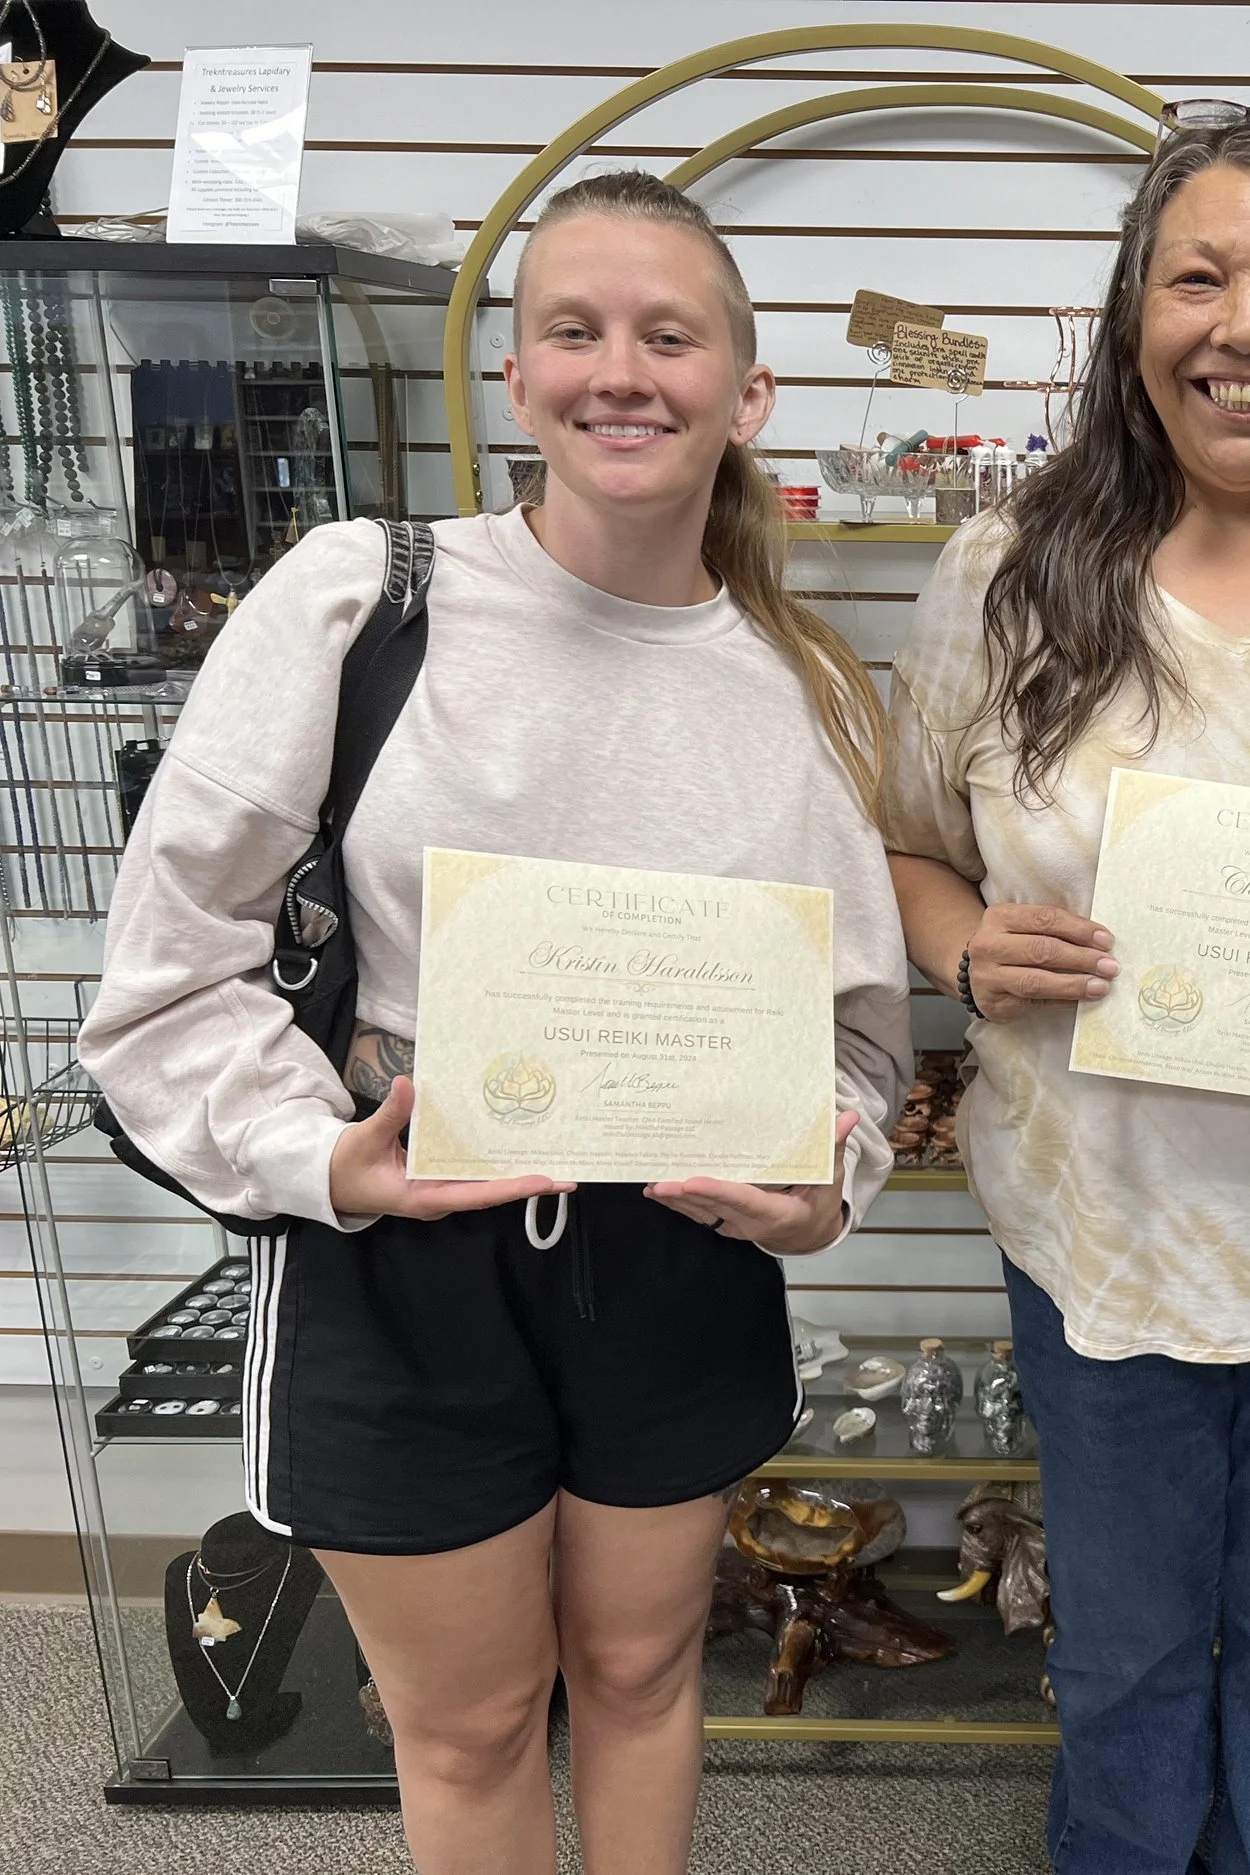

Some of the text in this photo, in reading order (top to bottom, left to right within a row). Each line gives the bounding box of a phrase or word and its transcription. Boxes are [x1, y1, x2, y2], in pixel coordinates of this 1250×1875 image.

[259, 67, 291, 76] Lapidary
[218, 85, 246, 93] Jewelry
[546, 884, 729, 919] CERTIFICATE
[601, 909, 681, 925] OF COMPLETION
[1149, 904, 1163, 912] has
[1164, 906, 1209, 920] successfully
[1210, 914, 1249, 926] completed
[1207, 926, 1233, 935] Master
[527, 938, 753, 984] Kristin Haraldsson
[1196, 943, 1240, 962] USUI
[502, 991, 552, 1002] successfully
[554, 995, 596, 1005] completed
[612, 998, 641, 1008] training
[644, 1000, 693, 1011] requirements
[766, 1008, 783, 1016] Reiki
[553, 1007, 580, 1015] Master
[583, 1009, 603, 1017] Level
[632, 1012, 661, 1022] granted
[663, 1014, 706, 1023] certification
[543, 1026, 732, 1050] USUI REIKI MASTER
[580, 1050, 618, 1058] Presented
[632, 1052, 657, 1061] August
[679, 1054, 696, 1062] 2024
